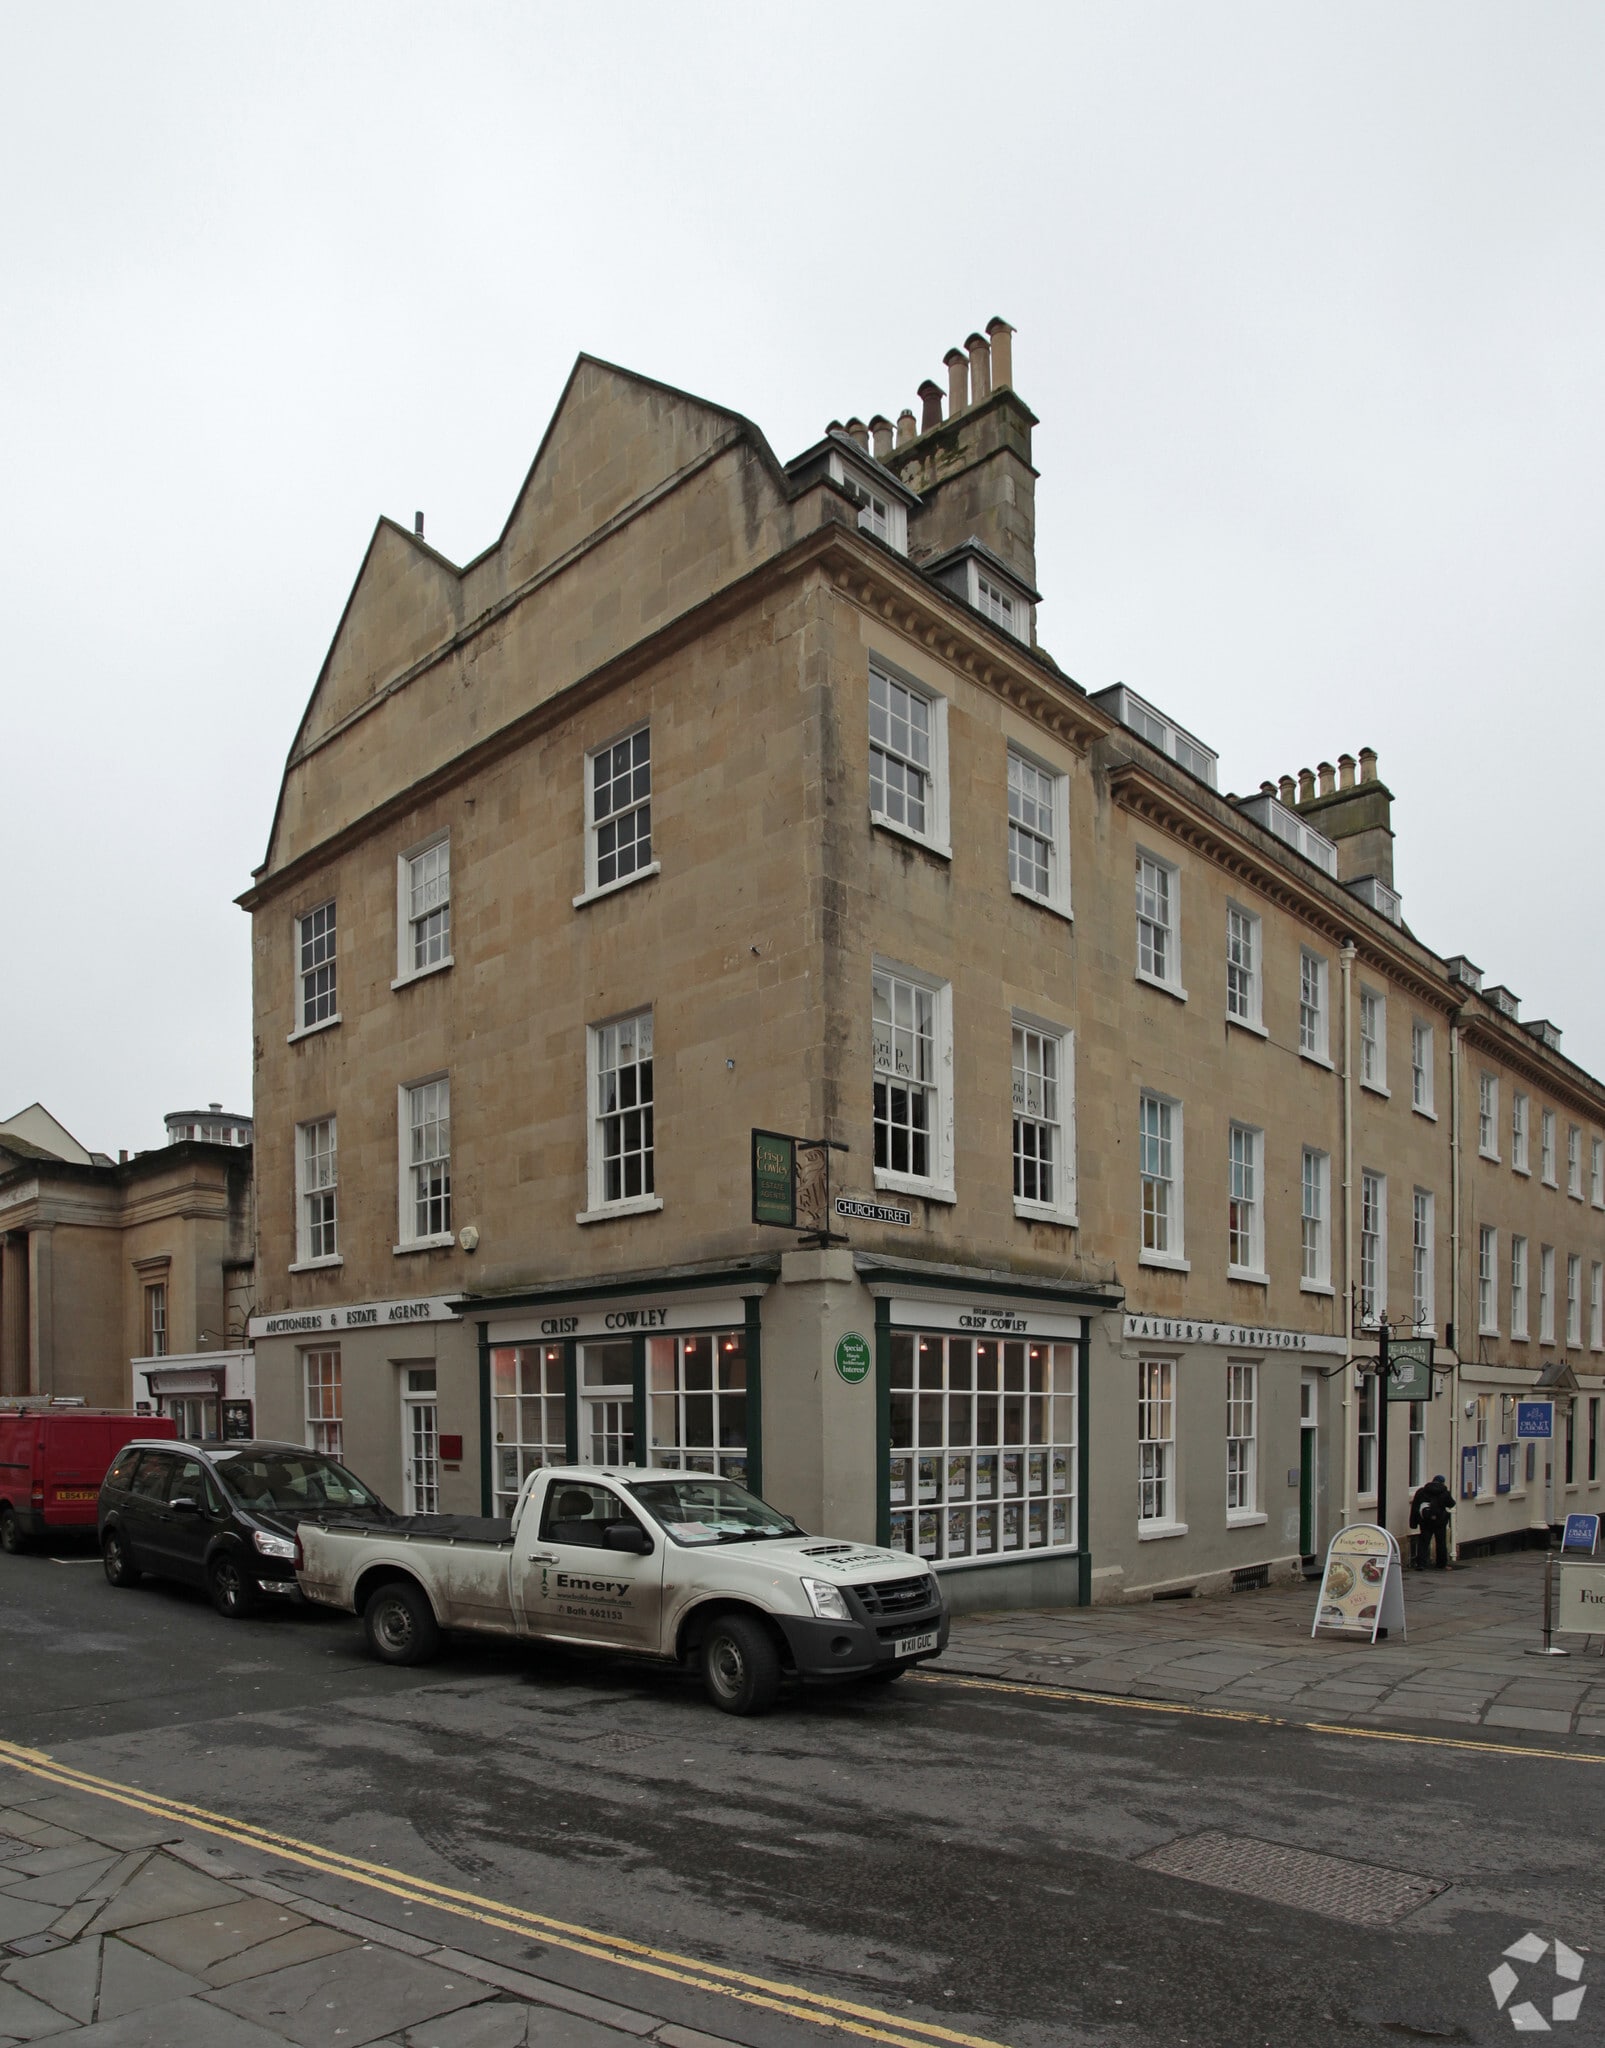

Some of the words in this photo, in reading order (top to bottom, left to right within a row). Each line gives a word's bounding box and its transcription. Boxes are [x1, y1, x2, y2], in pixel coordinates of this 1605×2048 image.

[837, 1201, 875, 1217] CHURCH
[877, 1207, 909, 1223] STREET
[266, 1315, 322, 1332] AUCTIONEERS
[331, 1314, 337, 1326] &
[347, 1309, 377, 1324] ESTATE
[389, 1303, 430, 1320] AGENTS
[541, 1317, 579, 1334] CRISP
[605, 1308, 667, 1328] COWLEY
[960, 1315, 986, 1328] CRISP
[991, 1318, 1028, 1332] COWLEY
[1130, 1318, 1203, 1339] VALUERS
[1213, 1328, 1220, 1340] &
[1230, 1329, 1307, 1348] SURVEYORS
[557, 1574, 630, 1597] Emery
[566, 1606, 588, 1616] Bath
[589, 1608, 623, 1620] 462153
